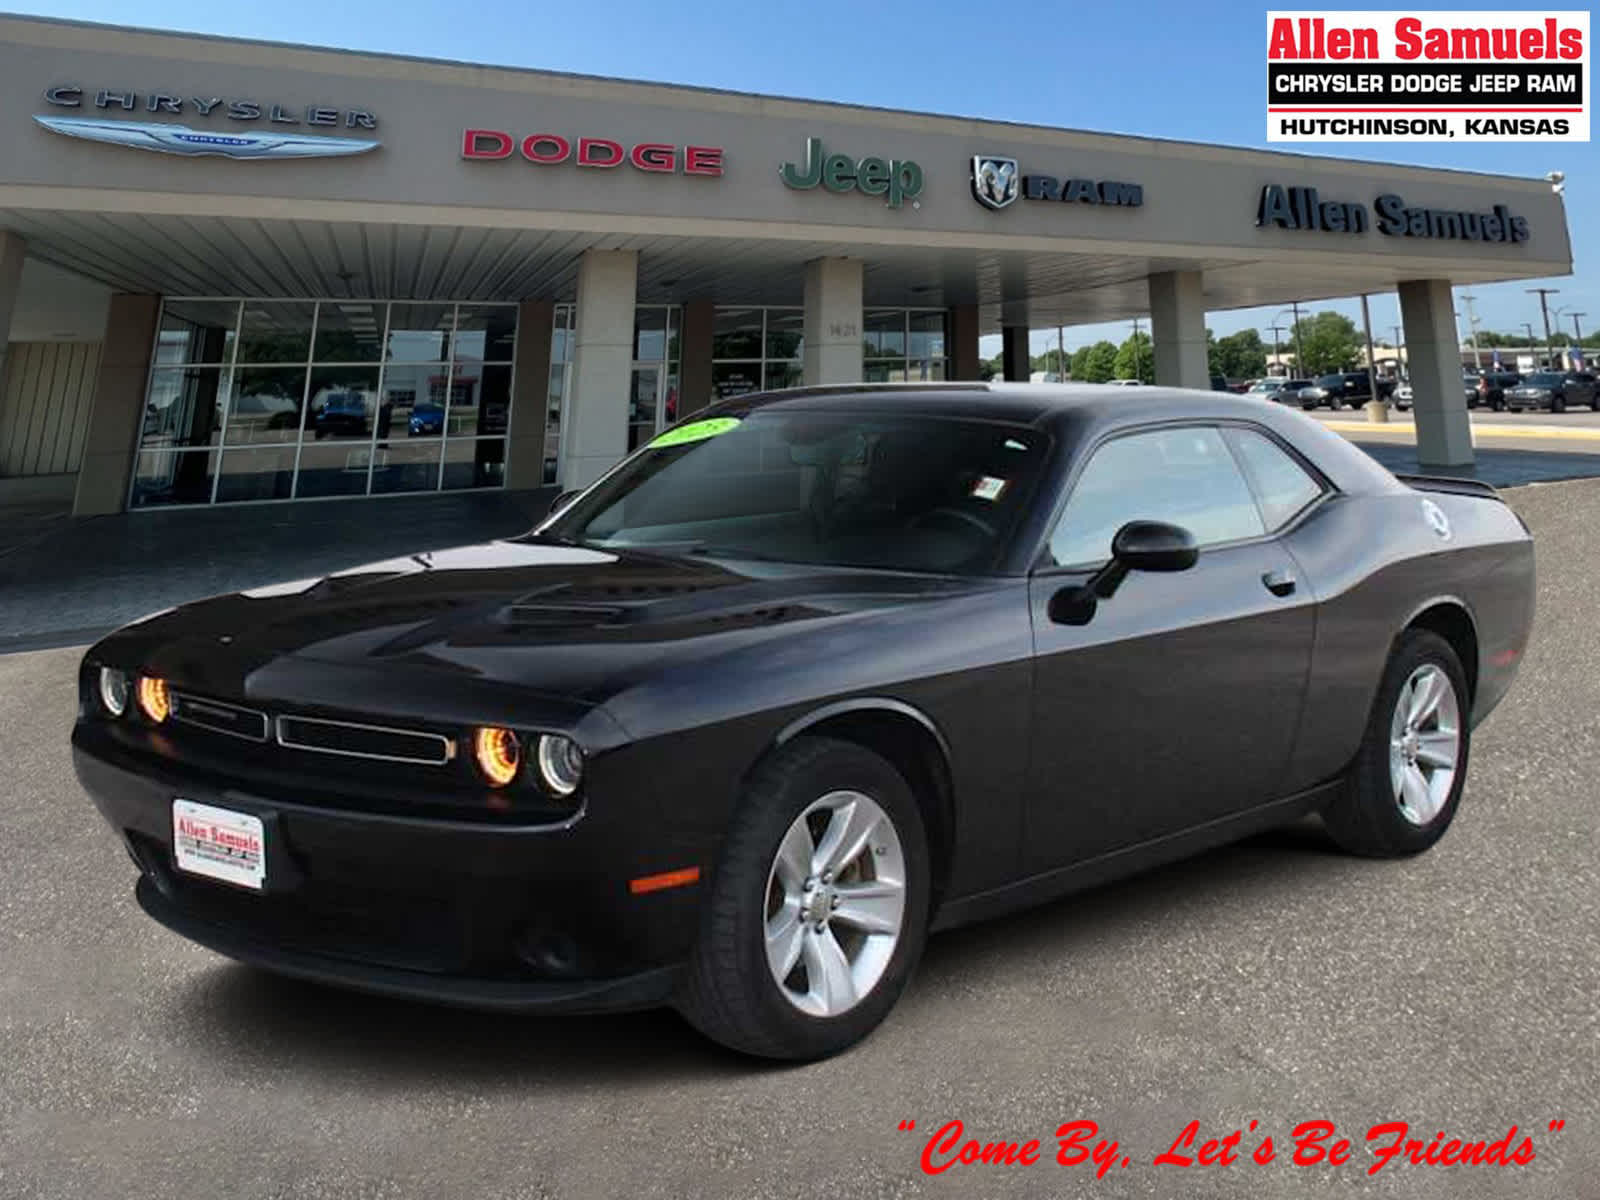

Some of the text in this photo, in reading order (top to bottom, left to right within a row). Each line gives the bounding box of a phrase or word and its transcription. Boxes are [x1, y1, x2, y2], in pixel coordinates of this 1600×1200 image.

[45, 86, 378, 129] CHRYSLER
[461, 128, 724, 177] DODGE
[778, 137, 924, 209] Jeep
[1022, 175, 1144, 207] RAM
[1256, 184, 1530, 243] Allen Samuels
[179, 817, 208, 839] Allen
